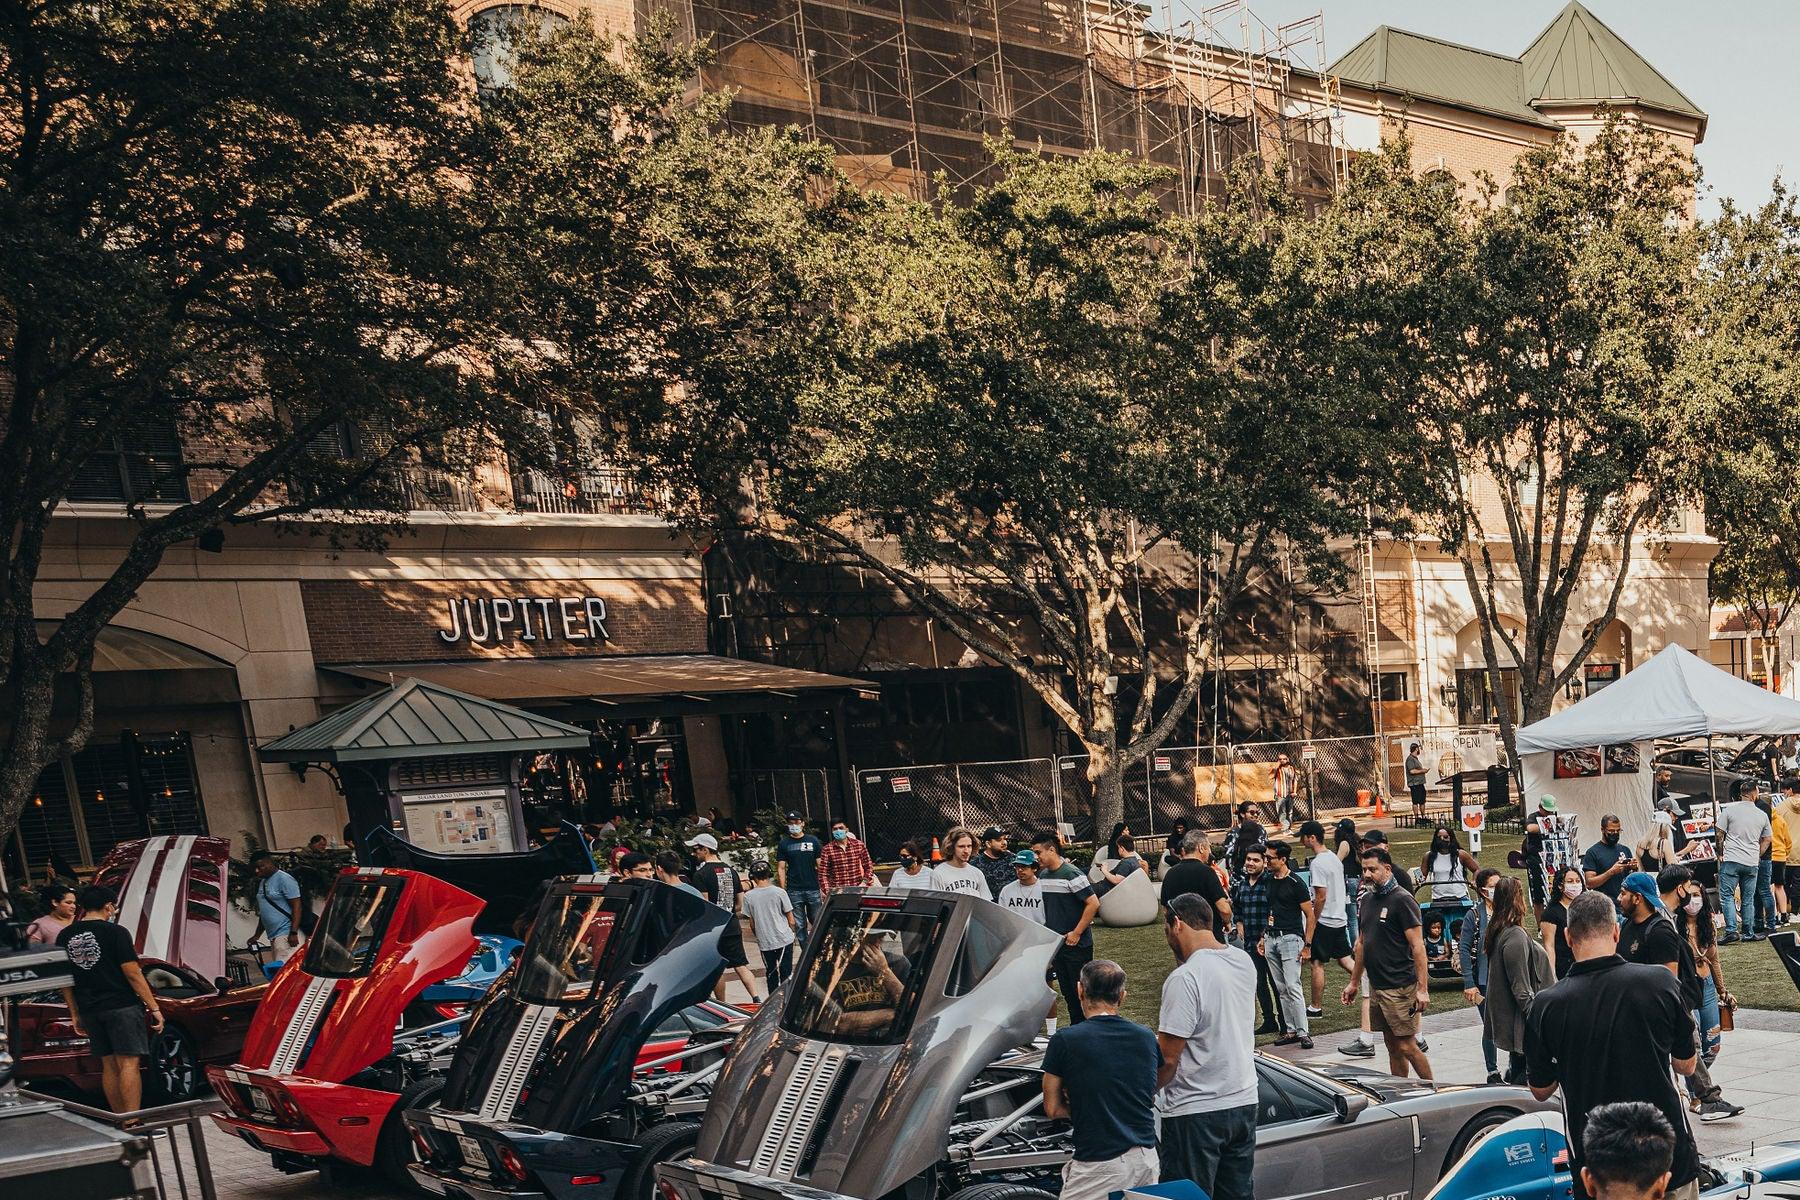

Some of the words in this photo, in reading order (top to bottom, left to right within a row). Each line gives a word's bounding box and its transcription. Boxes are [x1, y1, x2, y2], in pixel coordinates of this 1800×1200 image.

[440, 597, 610, 642] JUPITER
[1453, 737, 1481, 748] OPEN!
[1008, 897, 1041, 908] ARMY
